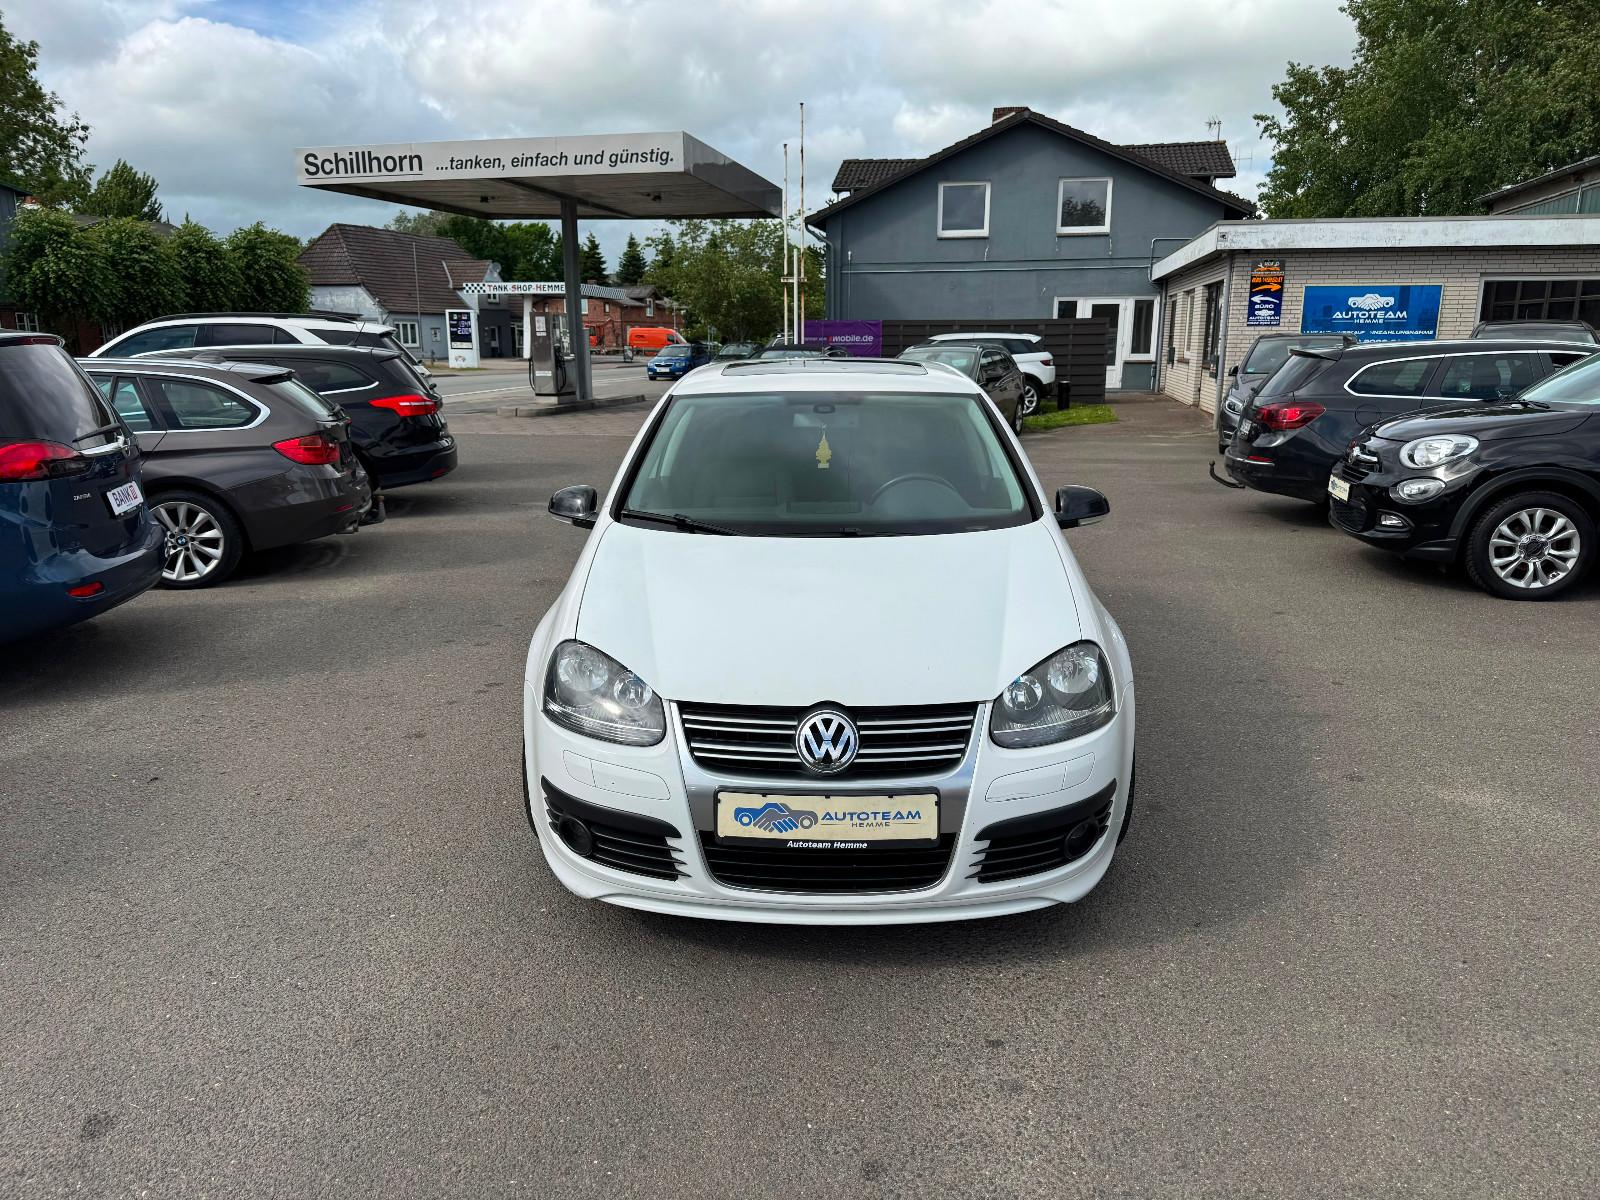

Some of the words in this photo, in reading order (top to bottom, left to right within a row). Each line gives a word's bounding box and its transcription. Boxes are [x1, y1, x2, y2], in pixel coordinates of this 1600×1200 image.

[304, 152, 423, 176] Schillhorn
[511, 150, 568, 168] einfach
[573, 150, 604, 166] und
[608, 148, 674, 168] günstig.
[1332, 311, 1408, 319] AUTOTEAM
[821, 810, 922, 822] AUTOTEAM
[786, 840, 832, 849] Autoteam
[833, 841, 868, 849] Hemme
